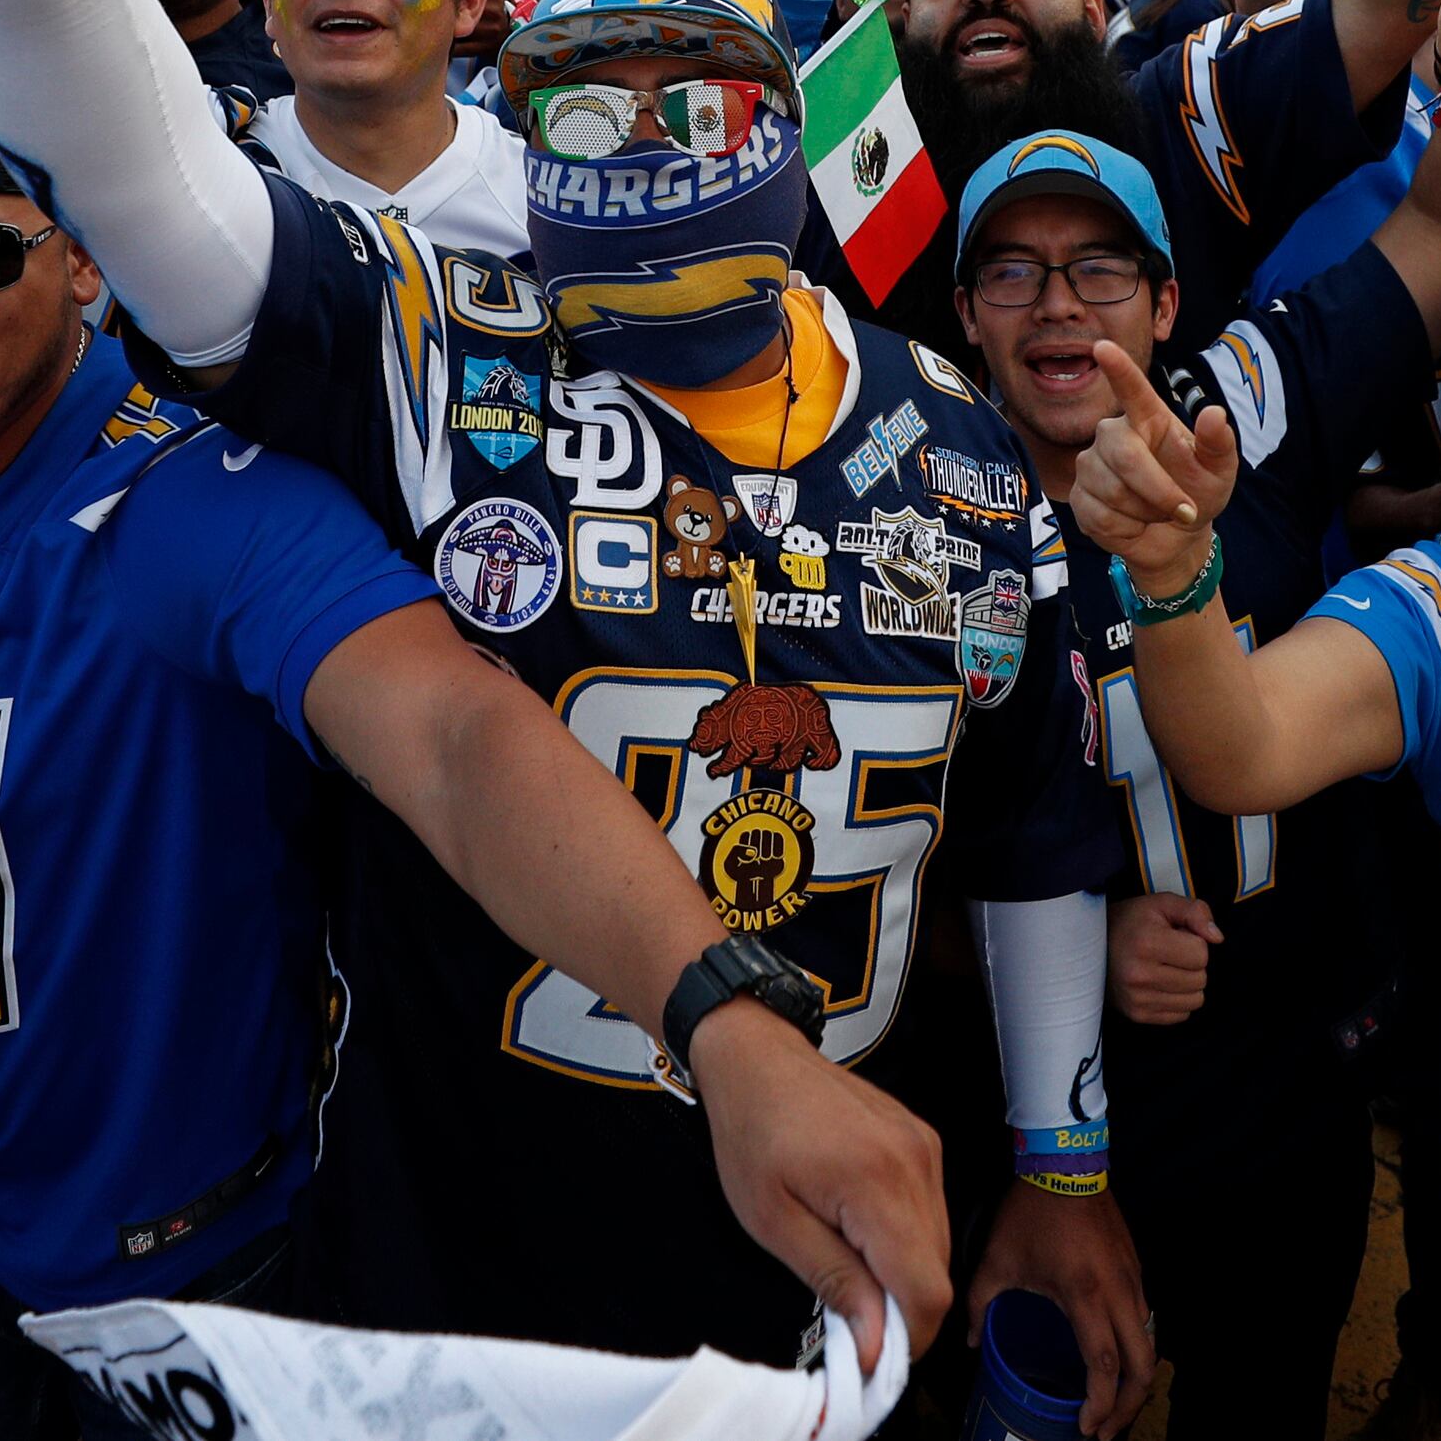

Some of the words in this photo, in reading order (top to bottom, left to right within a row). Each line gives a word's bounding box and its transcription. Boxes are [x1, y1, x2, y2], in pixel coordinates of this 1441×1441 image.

[526, 111, 784, 221] CHARGERS
[450, 403, 514, 431] LONDON
[932, 446, 981, 472] SOUTHERN
[740, 482, 790, 496] EQUIPMNT
[466, 504, 511, 524] PANCHO
[513, 508, 542, 534] BILLA
[439, 548, 454, 578] BILLS!
[545, 564, 558, 595] 1979
[508, 606, 536, 626] 2019
[690, 587, 842, 629] CHRGERS
[866, 588, 958, 639] WORLDWIDE
[965, 629, 1024, 651] LONDON
[702, 790, 813, 838] CHICANO
[711, 889, 806, 933] POWER
[1050, 1178, 1100, 1193] Helmet
